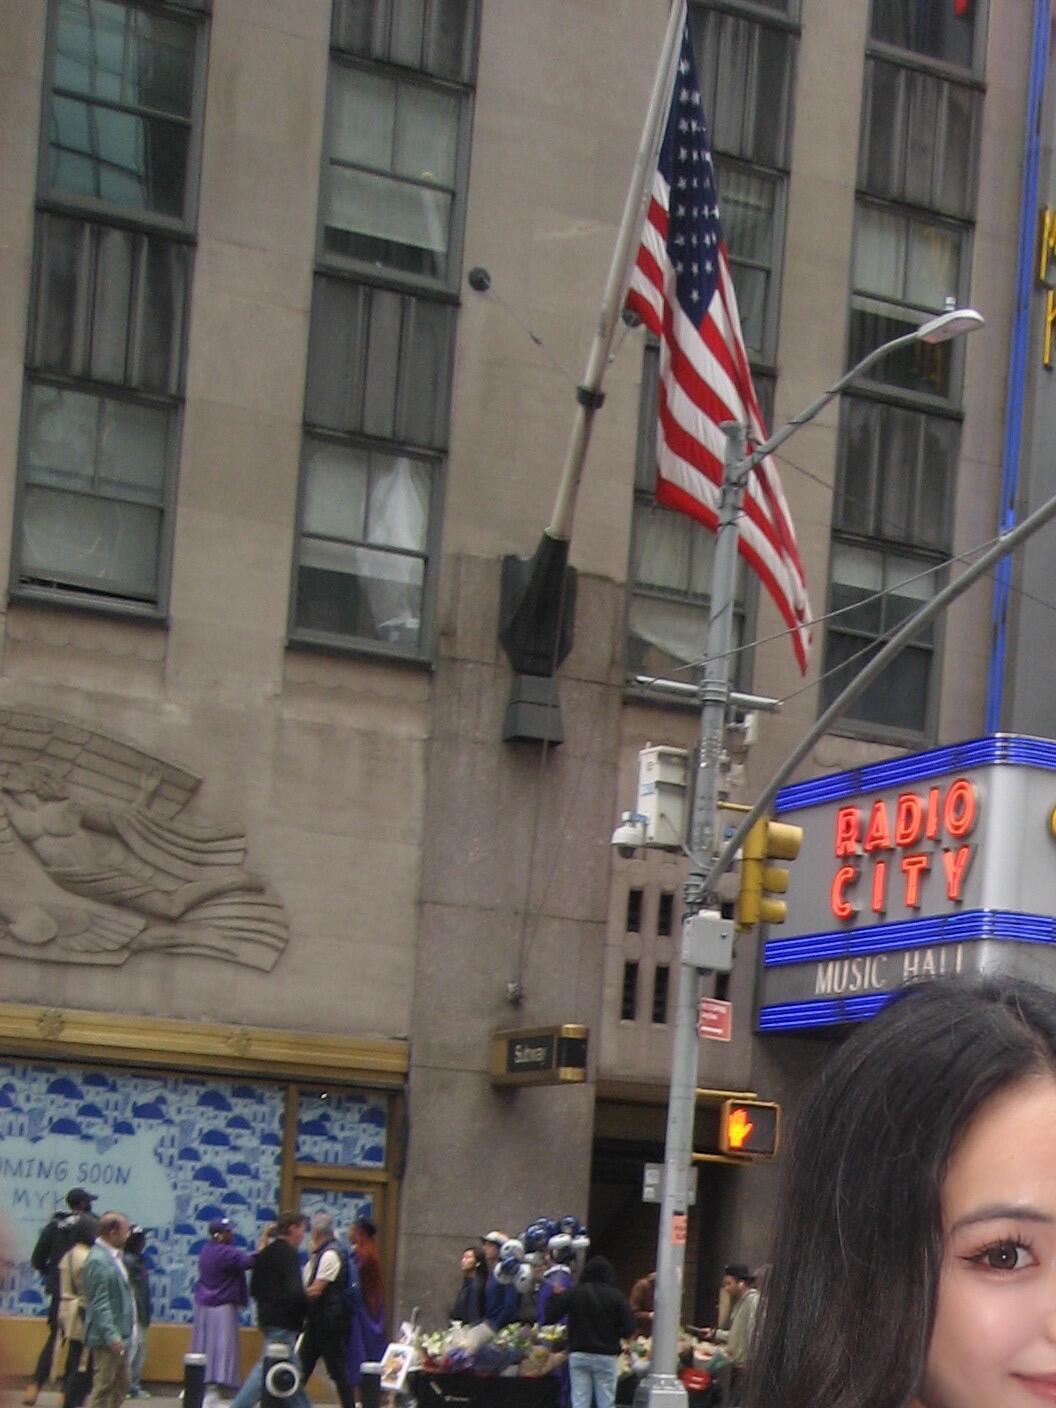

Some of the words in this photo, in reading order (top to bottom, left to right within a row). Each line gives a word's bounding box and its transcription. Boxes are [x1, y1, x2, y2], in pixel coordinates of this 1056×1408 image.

[835, 778, 976, 858] RADIO
[831, 844, 970, 920] CITY
[815, 954, 888, 994] MUSIC
[0, 1157, 69, 1183] MING
[77, 1162, 131, 1185] SOON
